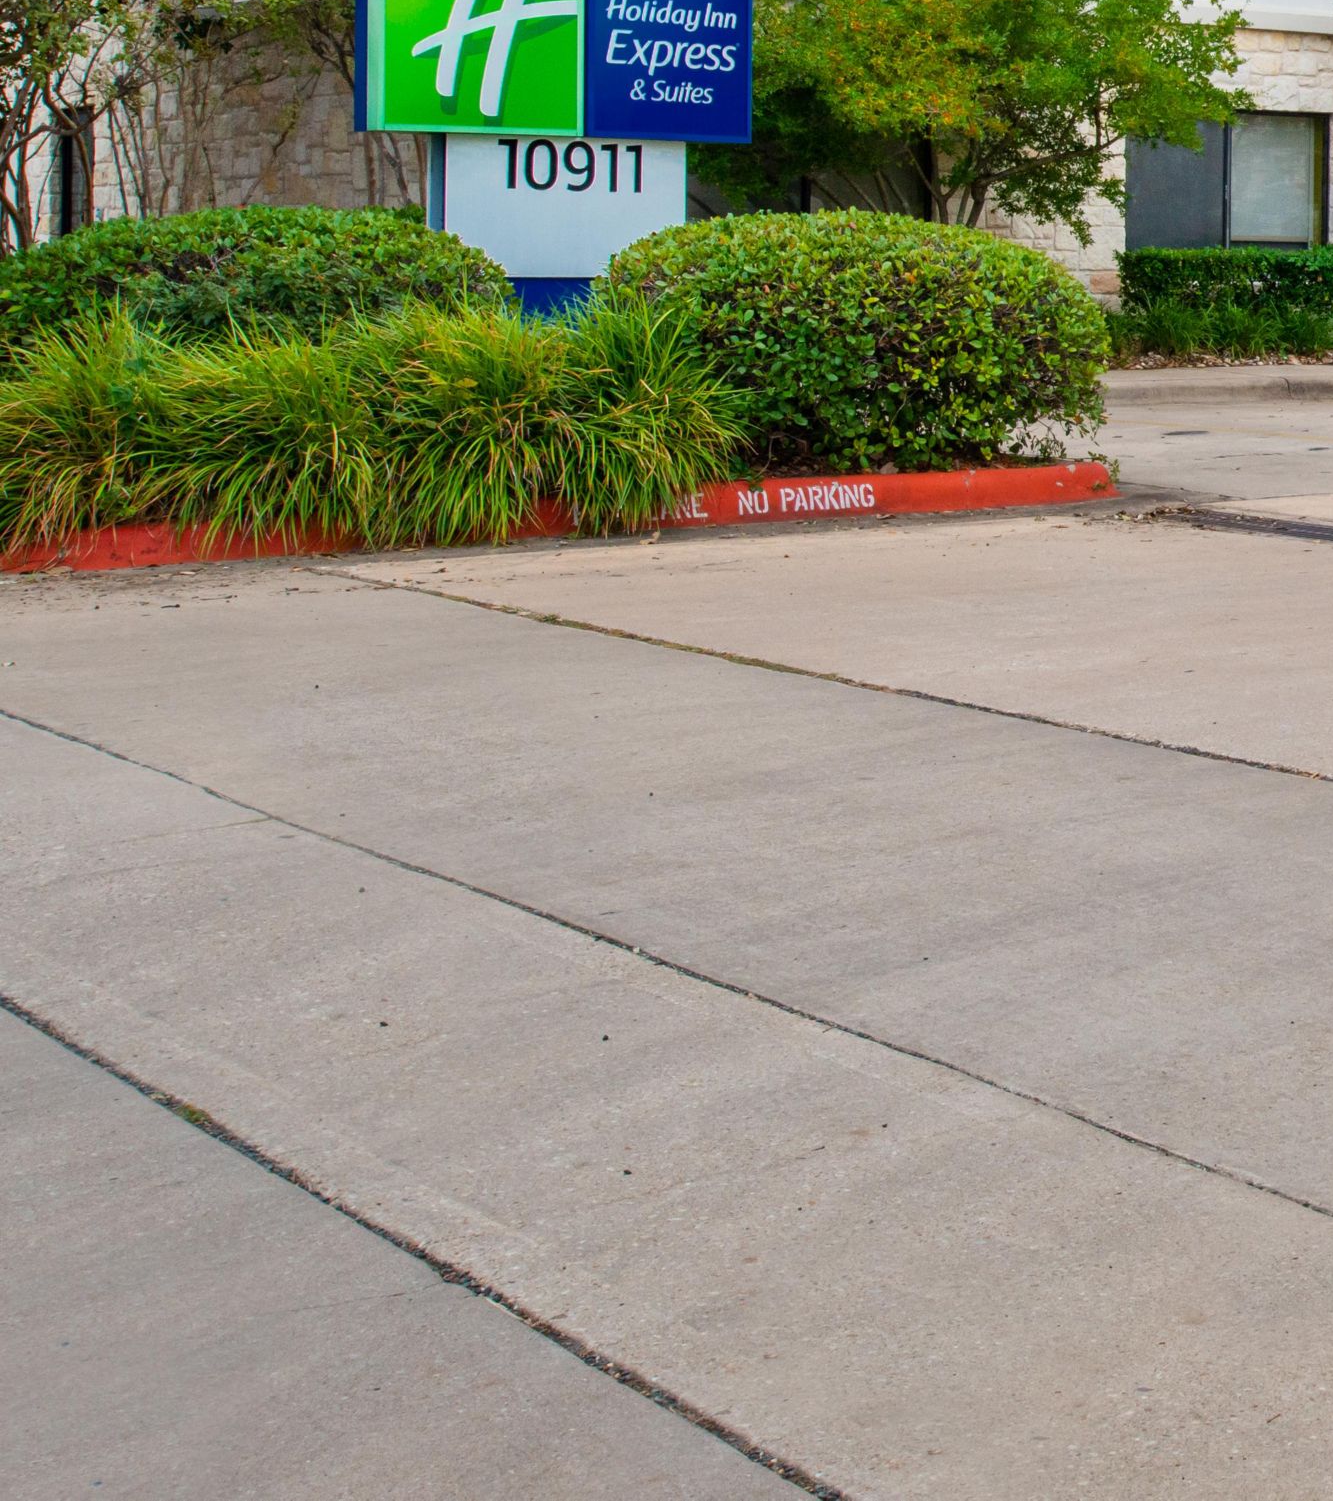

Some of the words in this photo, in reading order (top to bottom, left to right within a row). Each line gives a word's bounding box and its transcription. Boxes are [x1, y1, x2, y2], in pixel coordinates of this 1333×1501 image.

[703, 2, 737, 29] Inn
[605, 28, 737, 76] Express
[629, 78, 647, 101] &
[650, 79, 714, 105] Suites
[498, 138, 643, 194] 10911
[737, 489, 769, 516] NO
[780, 481, 876, 512] PARKING
